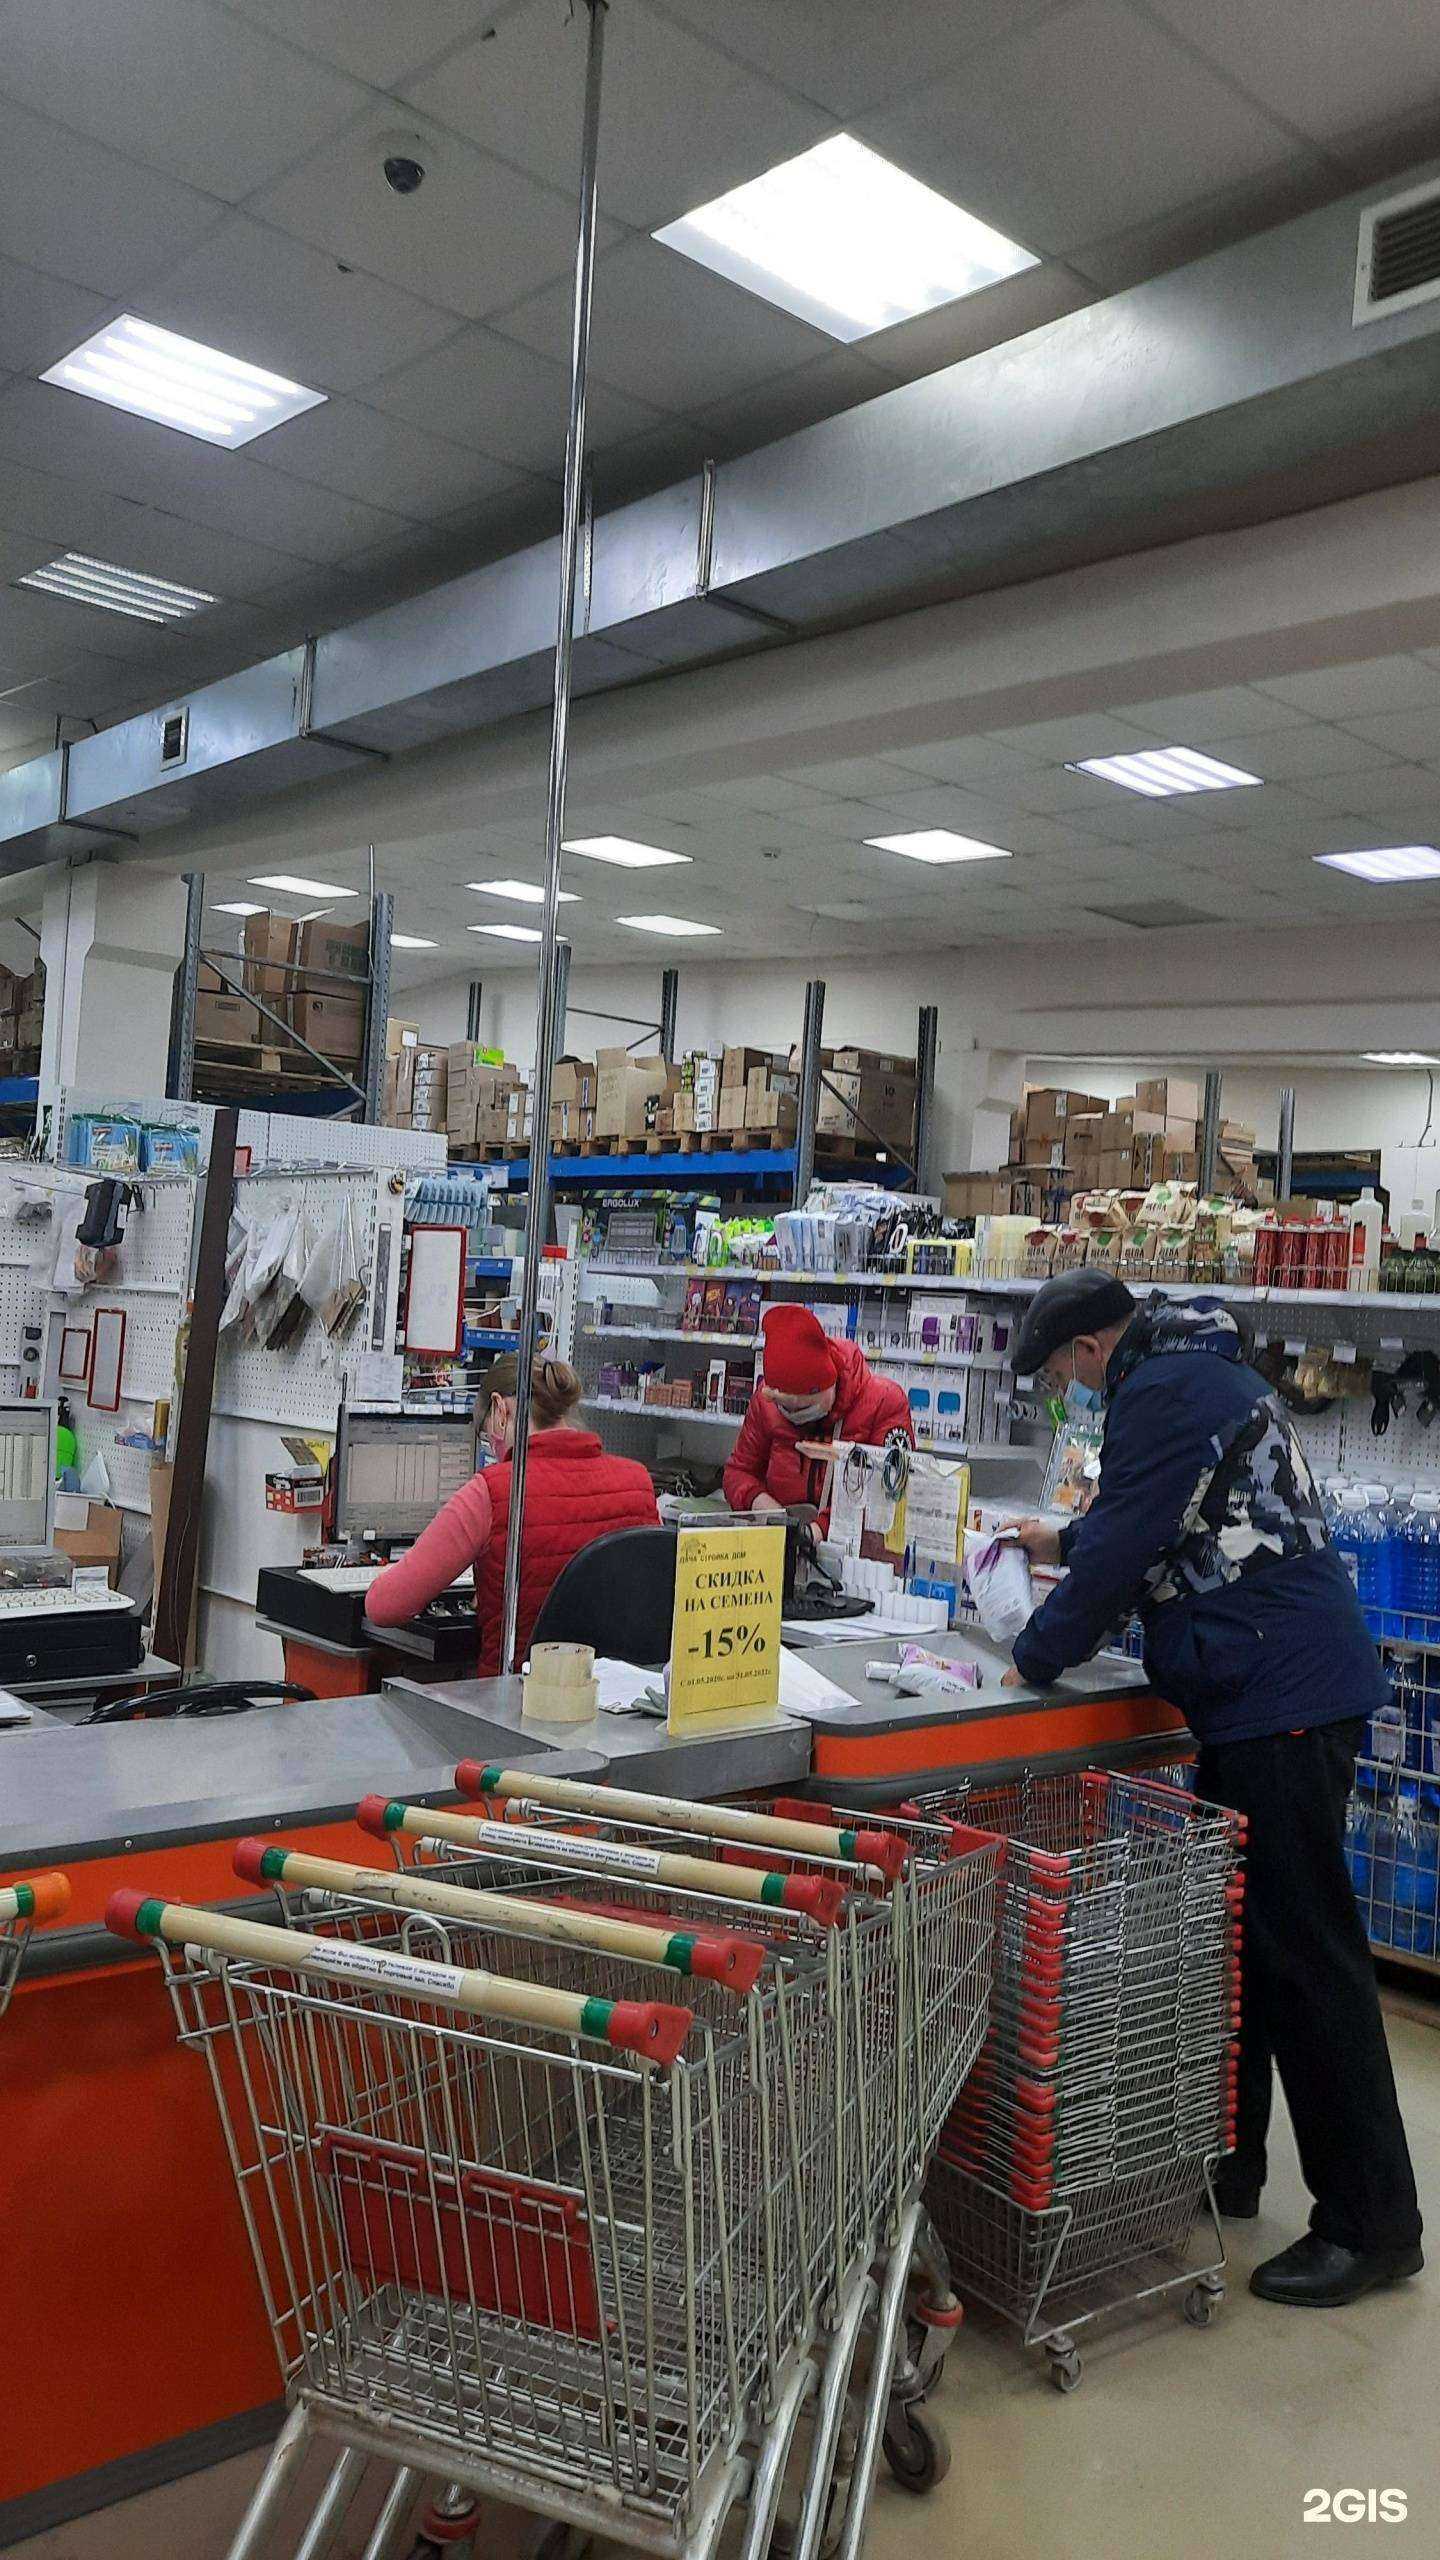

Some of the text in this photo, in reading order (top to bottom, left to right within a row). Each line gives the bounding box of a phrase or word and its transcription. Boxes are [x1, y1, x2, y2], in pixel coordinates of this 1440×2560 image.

[602, 1198, 641, 1208] ERGOLUX
[695, 1568, 765, 1590] СКИДКА
[684, 1590, 774, 1612] НА СЕМЕНА
[688, 1622, 766, 1659] -15%
